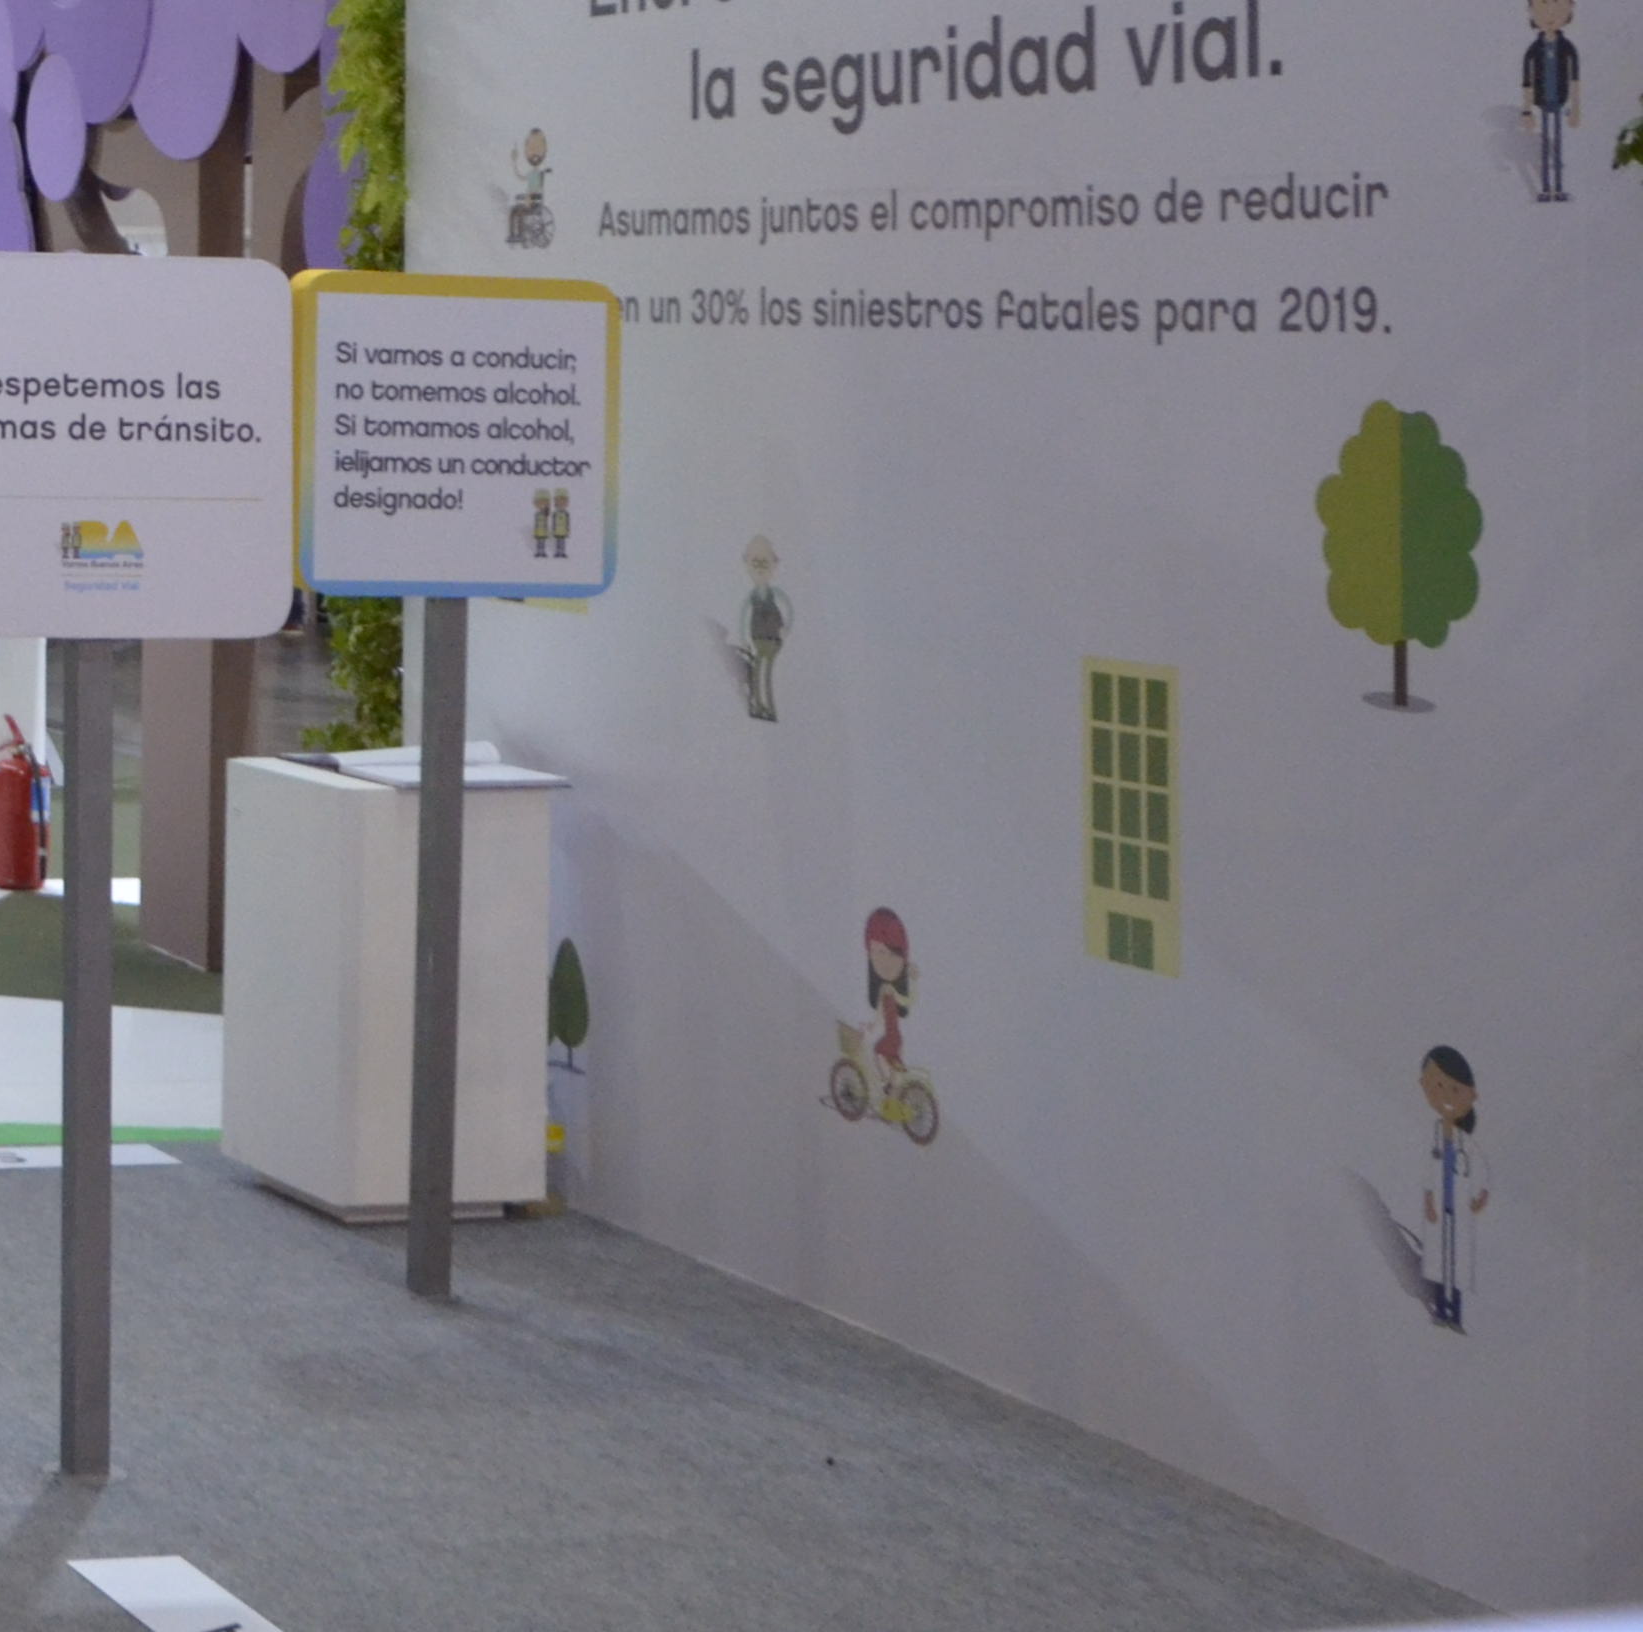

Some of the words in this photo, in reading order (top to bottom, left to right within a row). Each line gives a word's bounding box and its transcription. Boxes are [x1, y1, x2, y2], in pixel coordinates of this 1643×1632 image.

[691, 48, 735, 121] la
[761, 4, 1097, 136] seguridad
[598, 202, 751, 237] Asumamos
[759, 197, 859, 246] juntos
[870, 188, 898, 232] el
[910, 184, 1140, 242] compromiso
[1154, 177, 1204, 224] de
[1220, 171, 1389, 222] reducir
[650, 296, 681, 324] un
[691, 288, 749, 326] 30%
[760, 286, 802, 327] los
[813, 289, 984, 330] siniestros
[996, 286, 1140, 333] fatales
[1155, 298, 1257, 346] para
[1279, 285, 1392, 335] 2019.
[336, 341, 358, 364] Si
[364, 348, 444, 367] vamos
[450, 350, 465, 367] a
[472, 346, 577, 372] conducir,
[177, 372, 221, 400] las
[335, 382, 365, 401] no
[371, 380, 487, 404] tomemos
[493, 381, 581, 406] alcohol.
[67, 412, 107, 441] de
[118, 415, 261, 443] tránsito.
[335, 413, 357, 436] Si
[363, 416, 481, 440] tomamos
[486, 417, 575, 444] alcohol,
[334, 449, 433, 479] ¡elijamos
[437, 457, 465, 475] un
[470, 453, 591, 478] conductor
[333, 485, 463, 517] designado!
